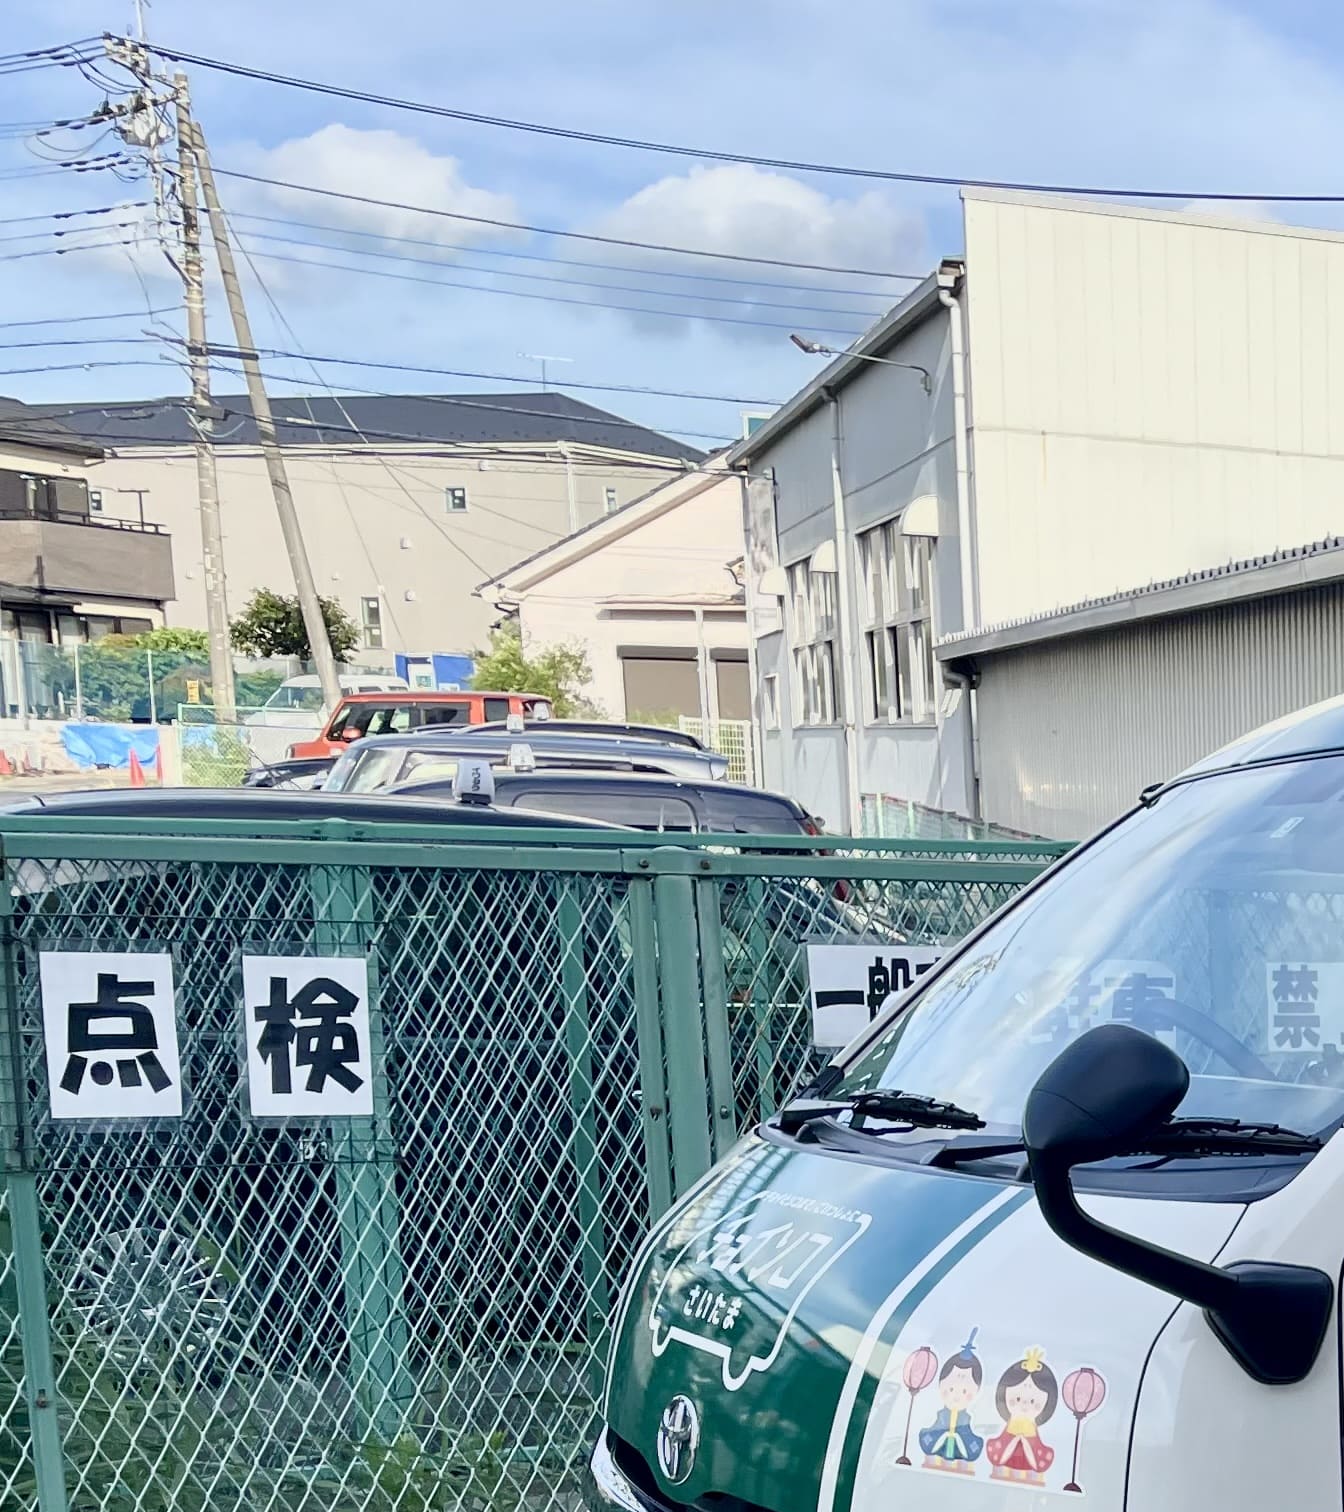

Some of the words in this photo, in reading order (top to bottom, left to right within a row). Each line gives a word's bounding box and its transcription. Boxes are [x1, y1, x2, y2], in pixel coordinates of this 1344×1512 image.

[815, 956, 942, 1022] 一般
[684, 1284, 742, 1329] さいたま
